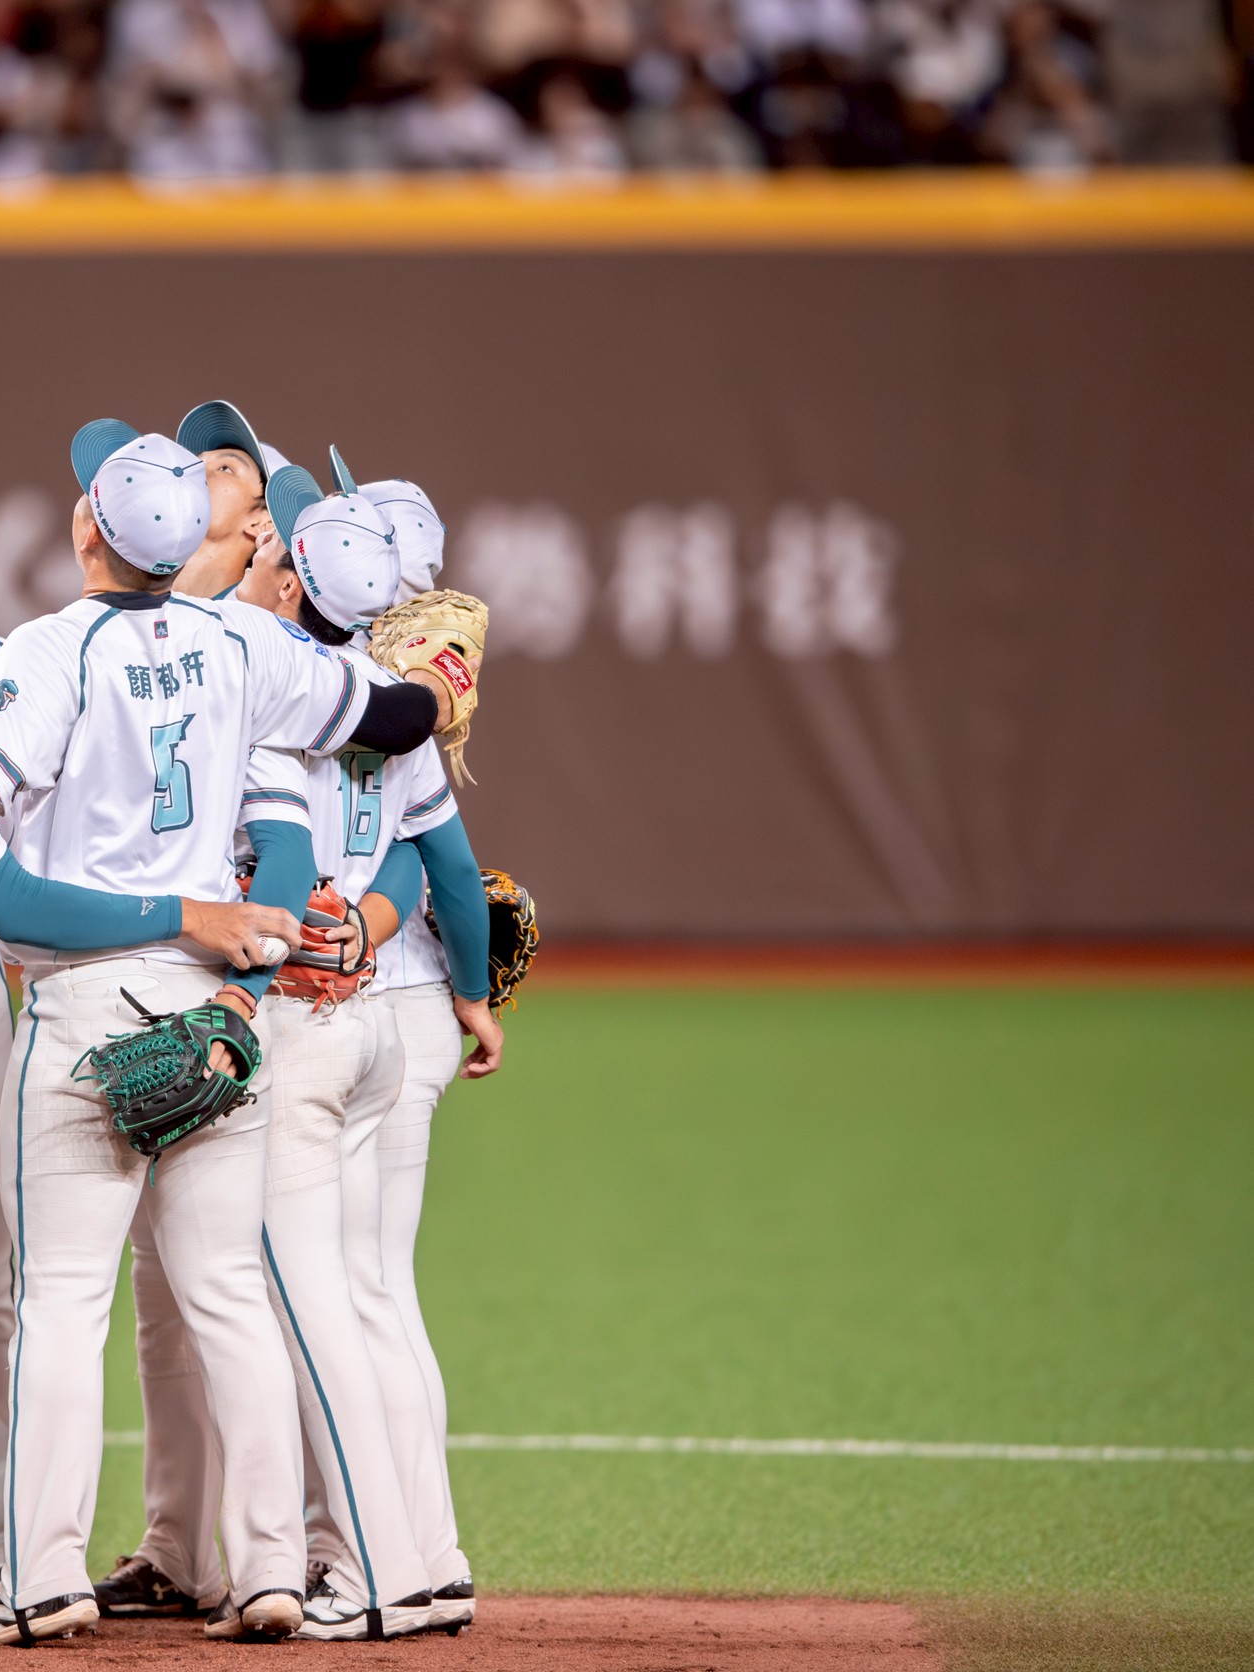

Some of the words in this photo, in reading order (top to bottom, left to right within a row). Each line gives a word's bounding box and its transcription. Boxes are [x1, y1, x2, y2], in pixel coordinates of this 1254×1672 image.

[151, 713, 196, 835] 5
[337, 750, 389, 858] 16
[156, 1114, 201, 1147] BRETT
